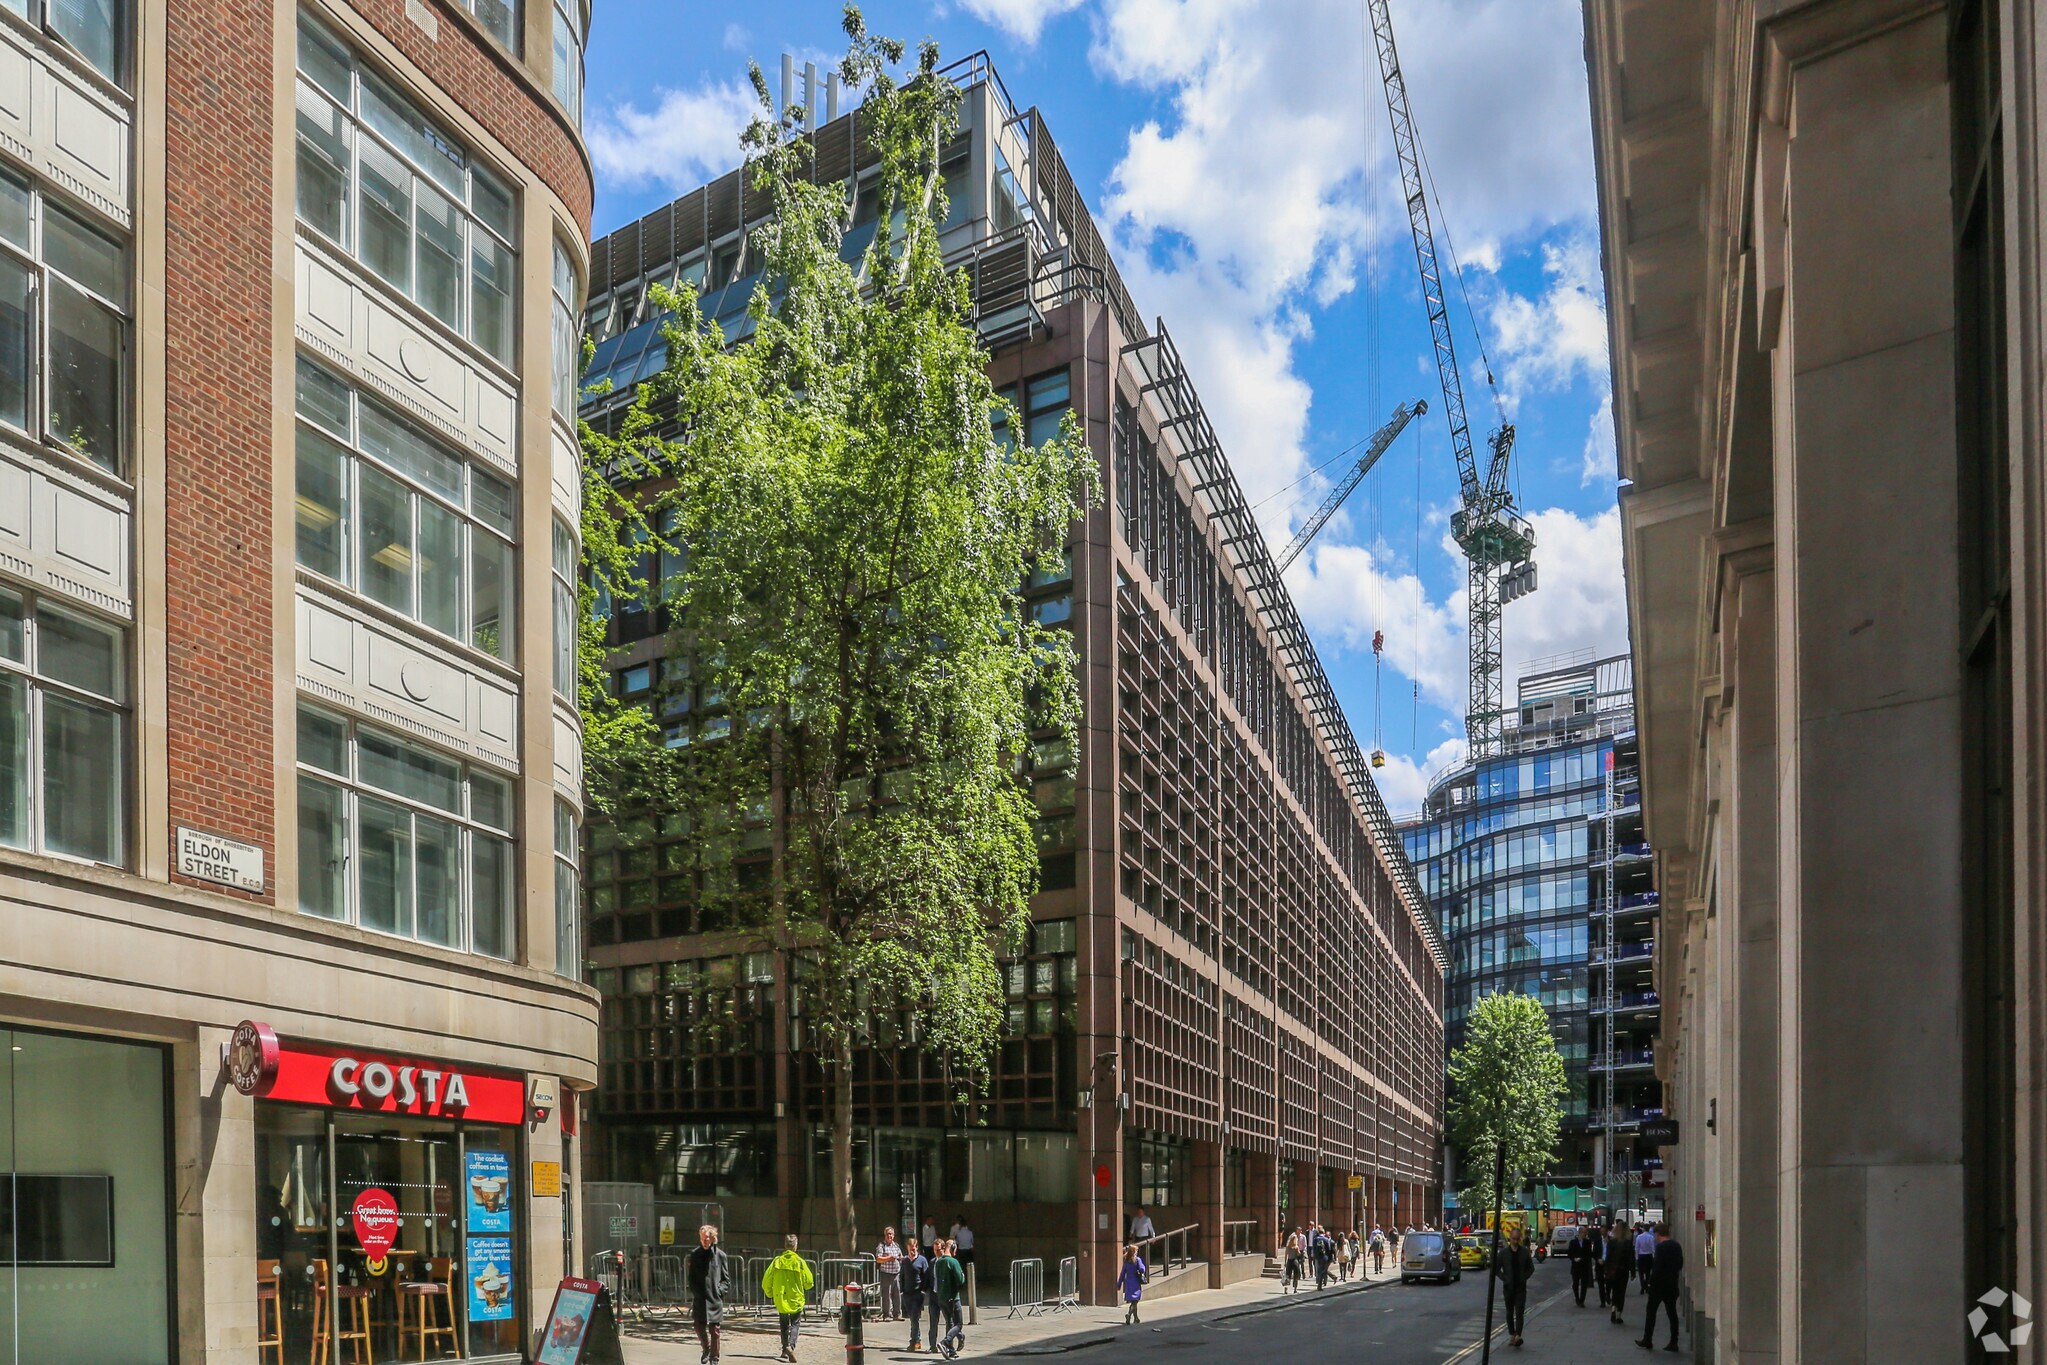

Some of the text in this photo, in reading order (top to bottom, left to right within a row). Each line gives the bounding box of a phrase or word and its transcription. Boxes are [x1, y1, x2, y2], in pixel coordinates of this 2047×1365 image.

[184, 839, 230, 864] ELDON
[185, 858, 238, 883] STREET
[235, 1027, 257, 1047] COSTA
[234, 1065, 259, 1088] COFFEE
[332, 1057, 470, 1106] COSTA
[1646, 1128, 1671, 1136] BOSS
[473, 1153, 505, 1163] The coolest
[469, 1161, 489, 1171] coffees
[490, 1162, 496, 1171] in
[357, 1204, 377, 1214] Great
[360, 1214, 371, 1223] No
[482, 1218, 501, 1226] COSTA
[472, 1240, 490, 1248] Coffee
[474, 1248, 483, 1257] get
[483, 1249, 493, 1257] any
[573, 1281, 588, 1290] COSTA
